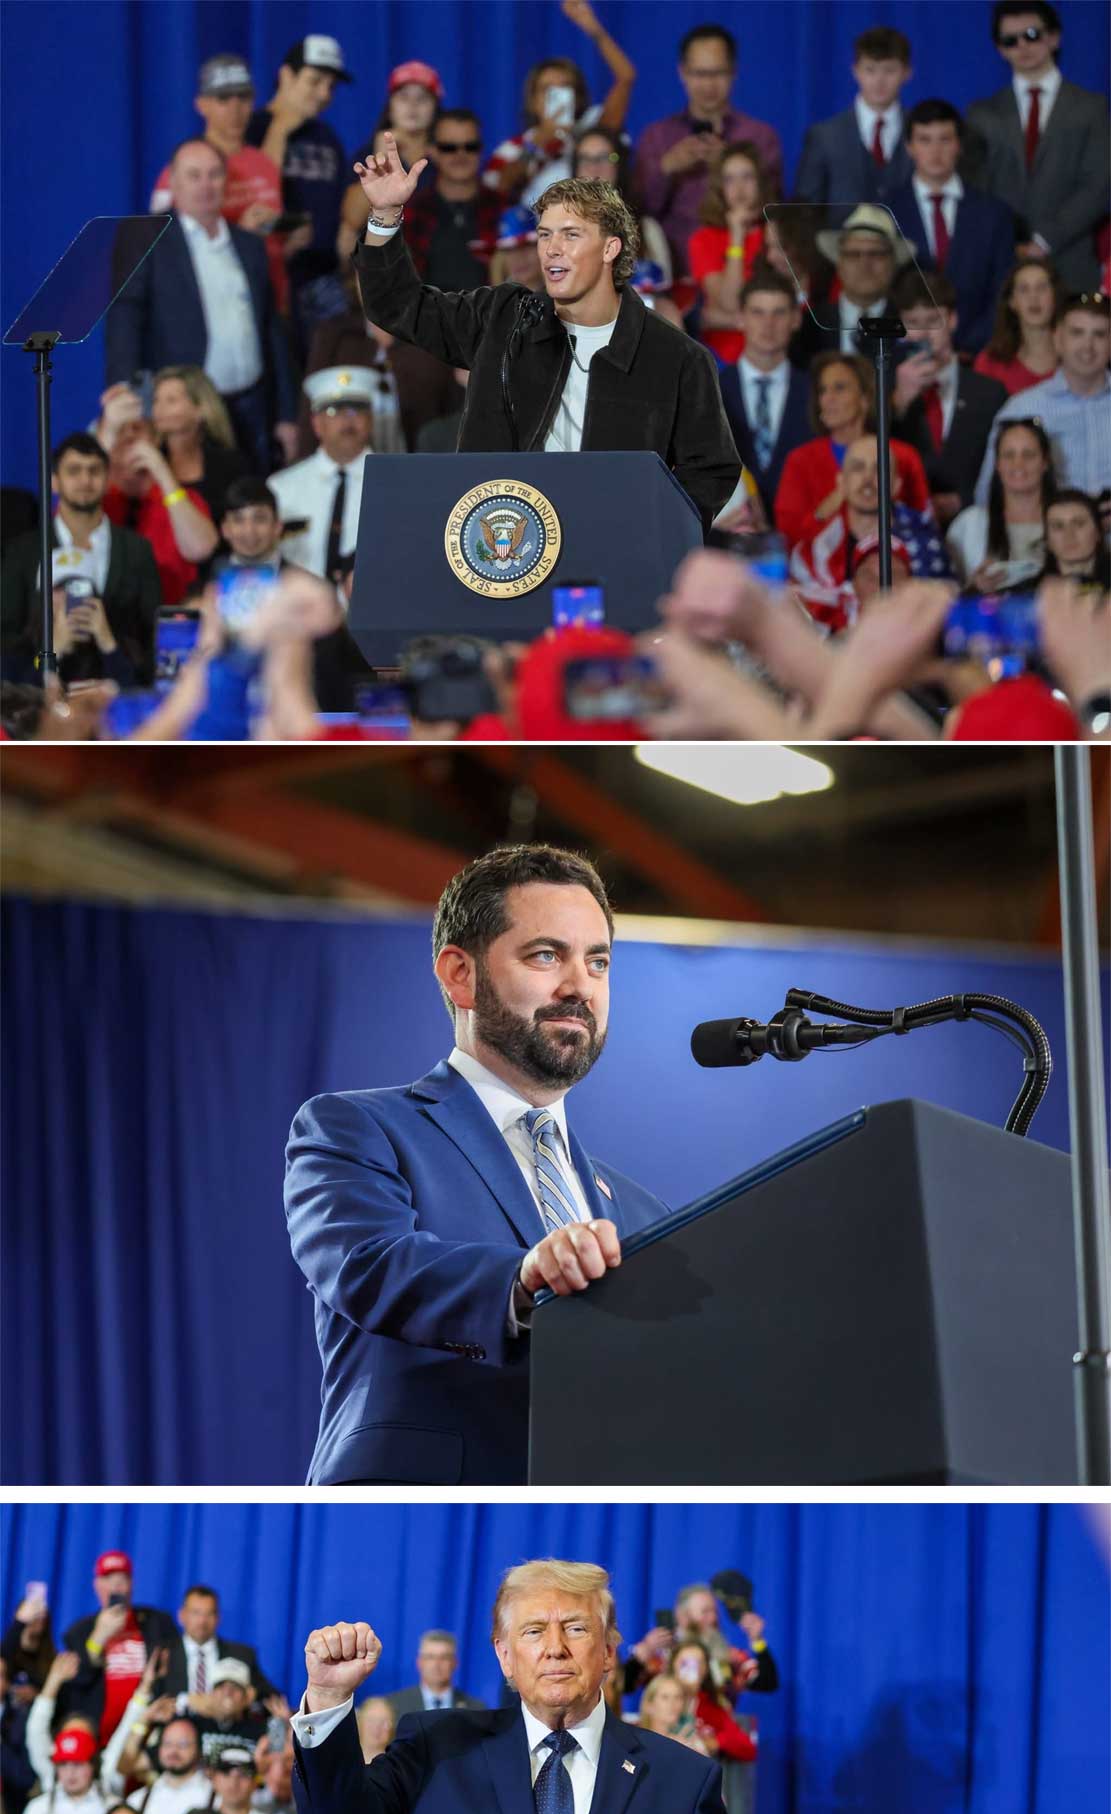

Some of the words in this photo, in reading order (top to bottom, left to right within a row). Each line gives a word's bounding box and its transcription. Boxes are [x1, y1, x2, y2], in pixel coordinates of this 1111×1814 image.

[449, 484, 502, 536] PRESIDENT
[517, 487, 532, 499] THE
[533, 498, 557, 545] UNITED
[463, 571, 492, 592] SEAL
[513, 556, 552, 592] STATES
